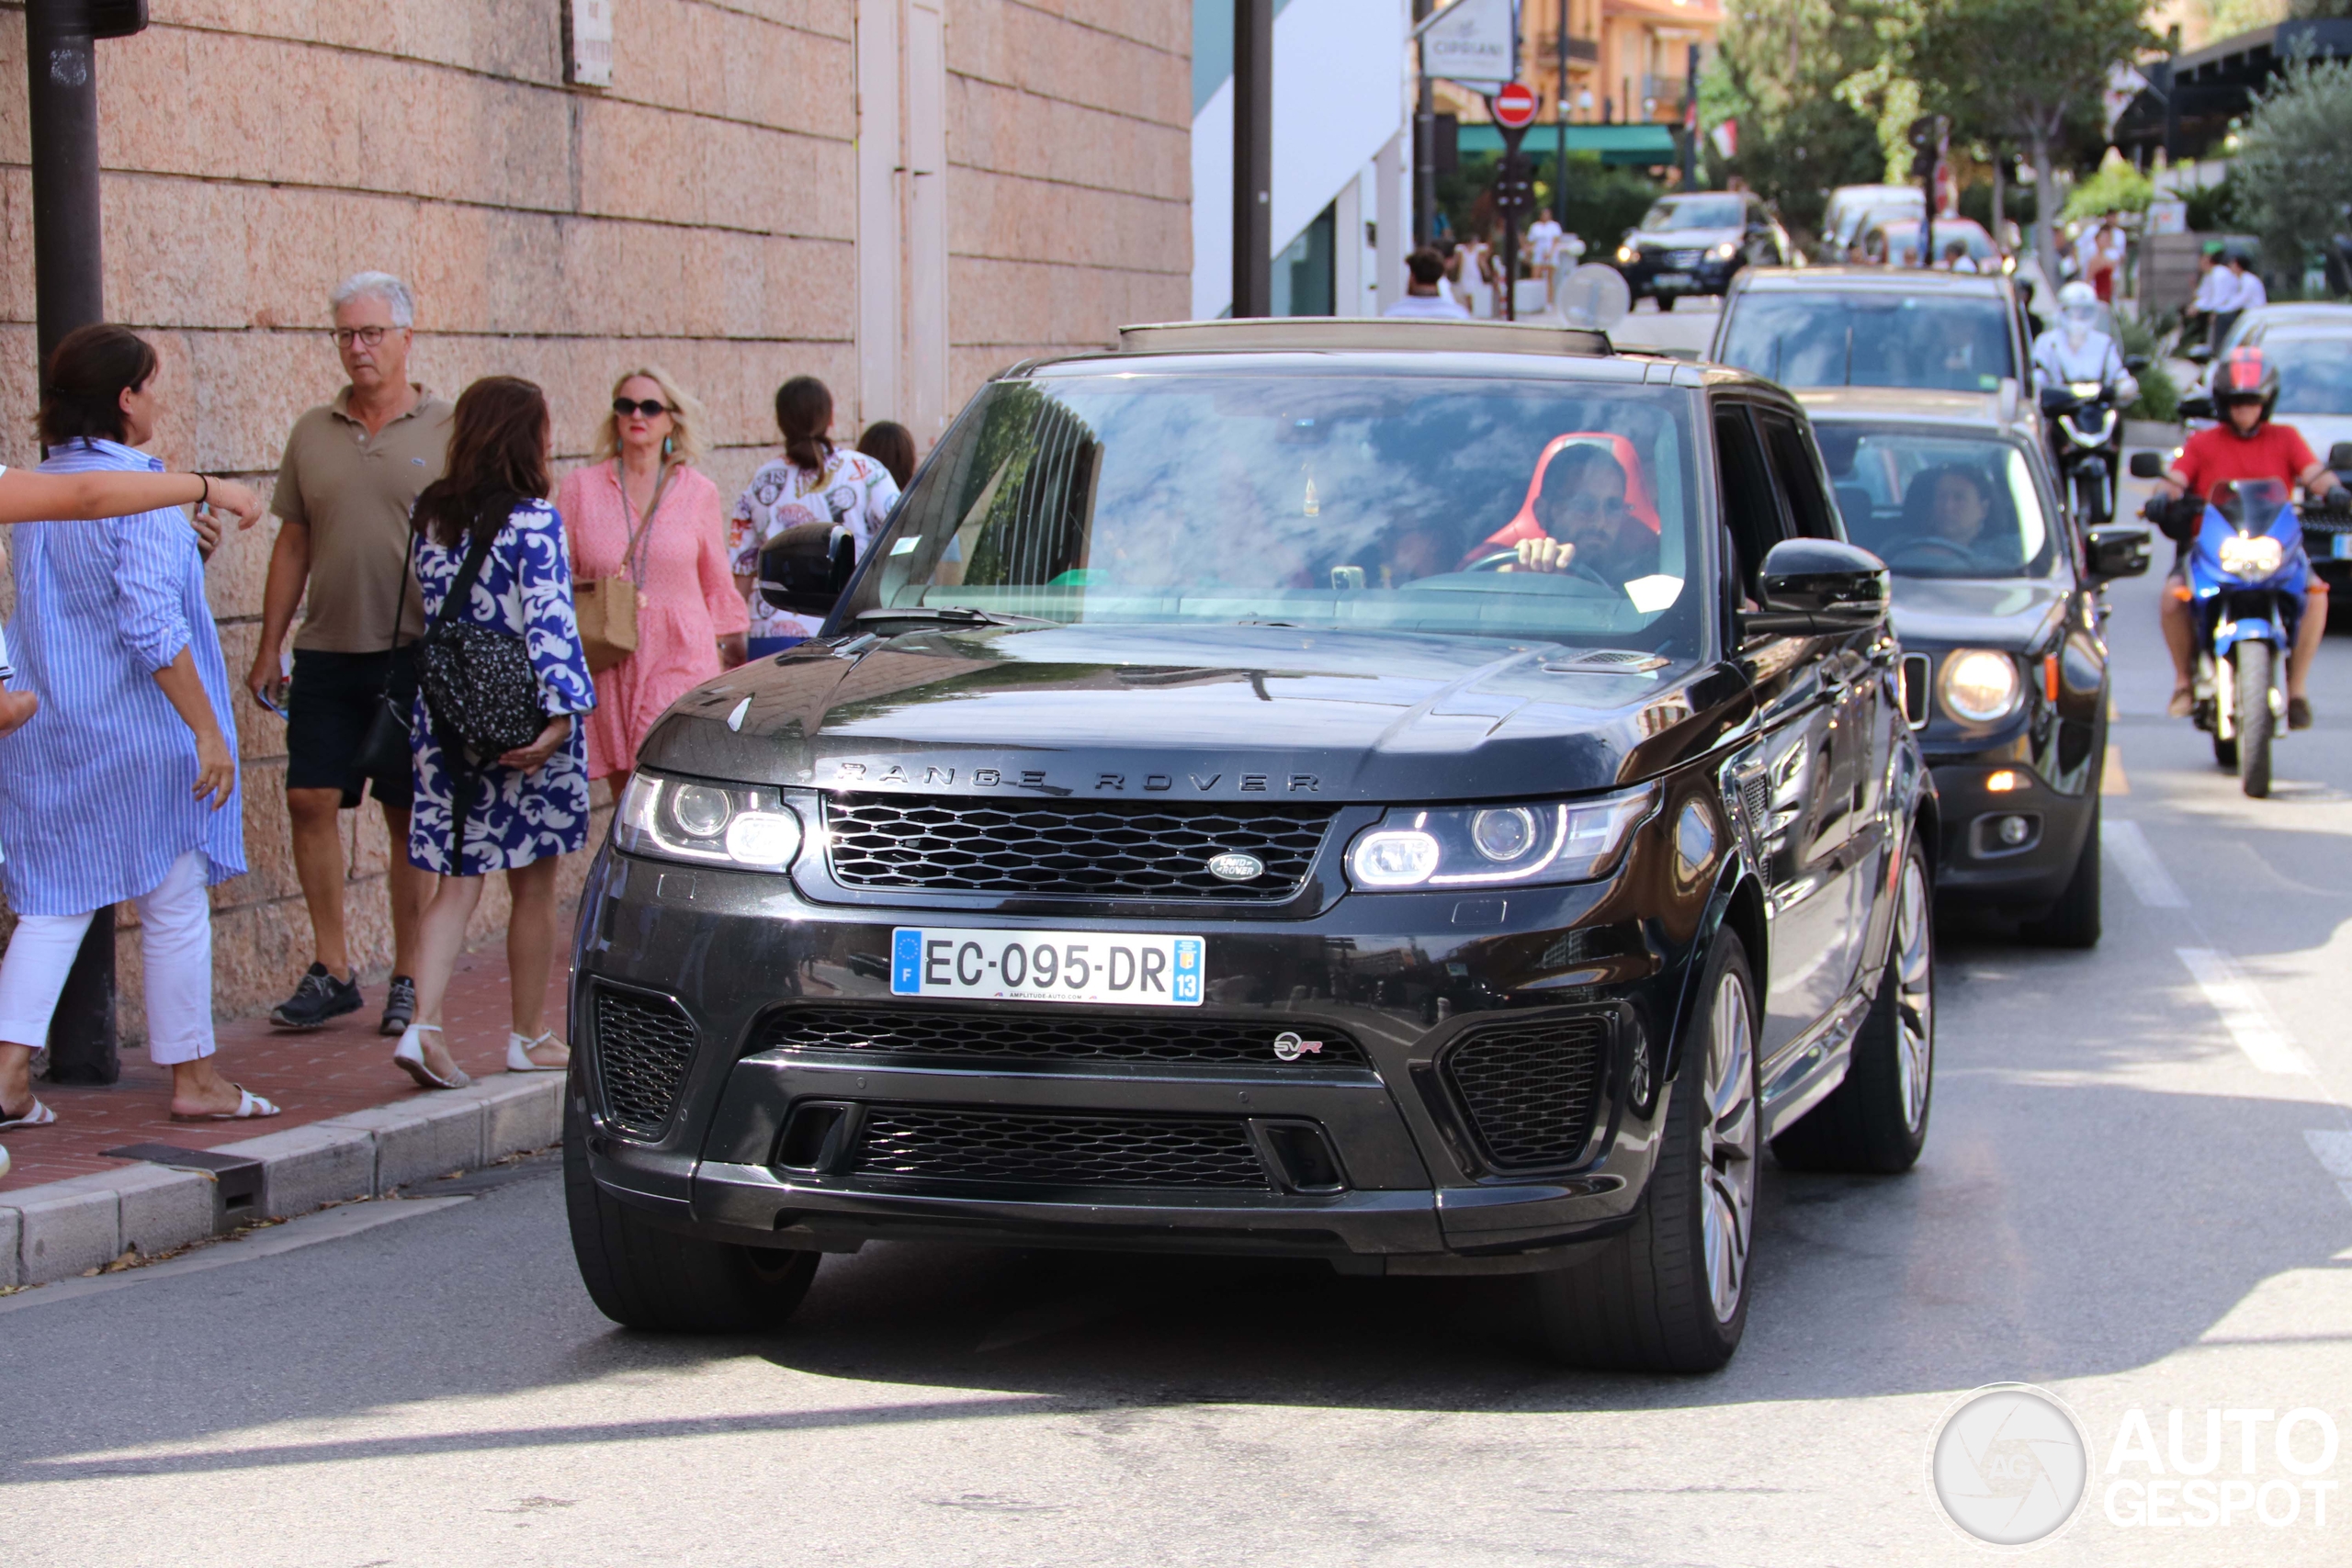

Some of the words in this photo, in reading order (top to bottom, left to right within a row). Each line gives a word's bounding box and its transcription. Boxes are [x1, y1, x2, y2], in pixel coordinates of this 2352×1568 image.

[1433, 40, 1504, 56] CIPRIANI
[837, 762, 1046, 788] RANGE
[1094, 773, 1319, 792] ROVER
[1219, 857, 1247, 867] LAND
[1222, 865, 1254, 875] ROVER
[925, 939, 1167, 993] EC-095-DR
[902, 968, 912, 982] F
[1176, 974, 1197, 998] 13
[1009, 992, 1082, 1000] AMPLITUDE-AUTO.COM
[1273, 1038, 1323, 1055] SVR
